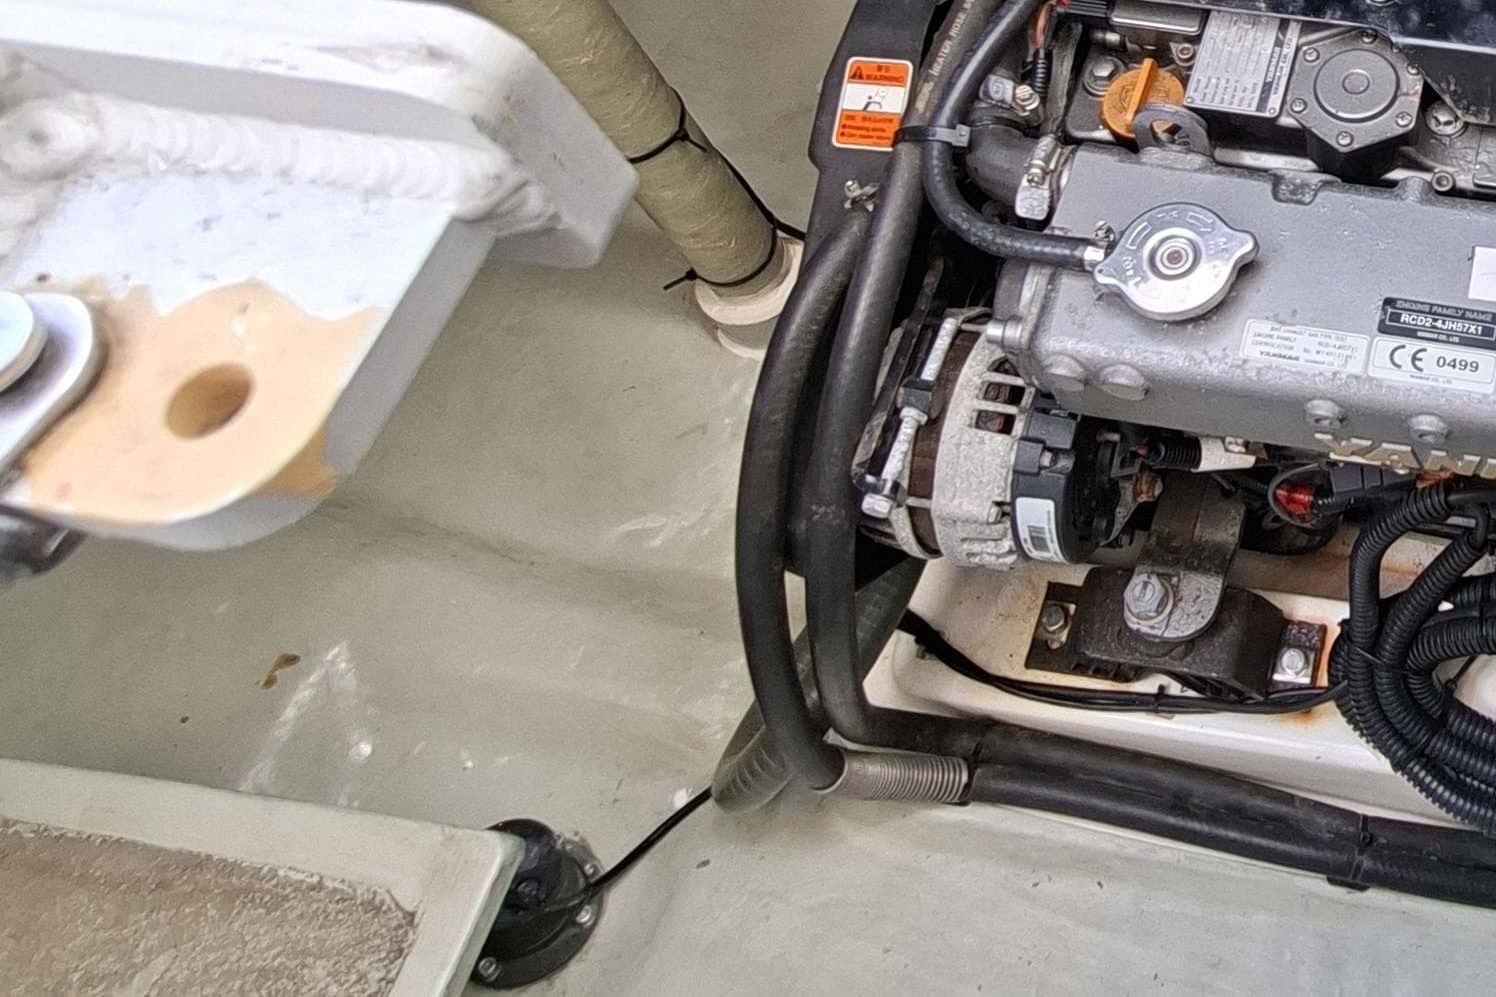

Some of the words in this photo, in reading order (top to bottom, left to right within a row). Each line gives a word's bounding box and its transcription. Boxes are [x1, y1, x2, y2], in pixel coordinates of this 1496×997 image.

[1431, 304, 1465, 317] FAMILY
[1465, 309, 1493, 321] NAME
[1400, 314, 1483, 335] RCD2-4JH57X1
[1258, 350, 1301, 362] YANMAR
[1436, 356, 1479, 373] 0499
